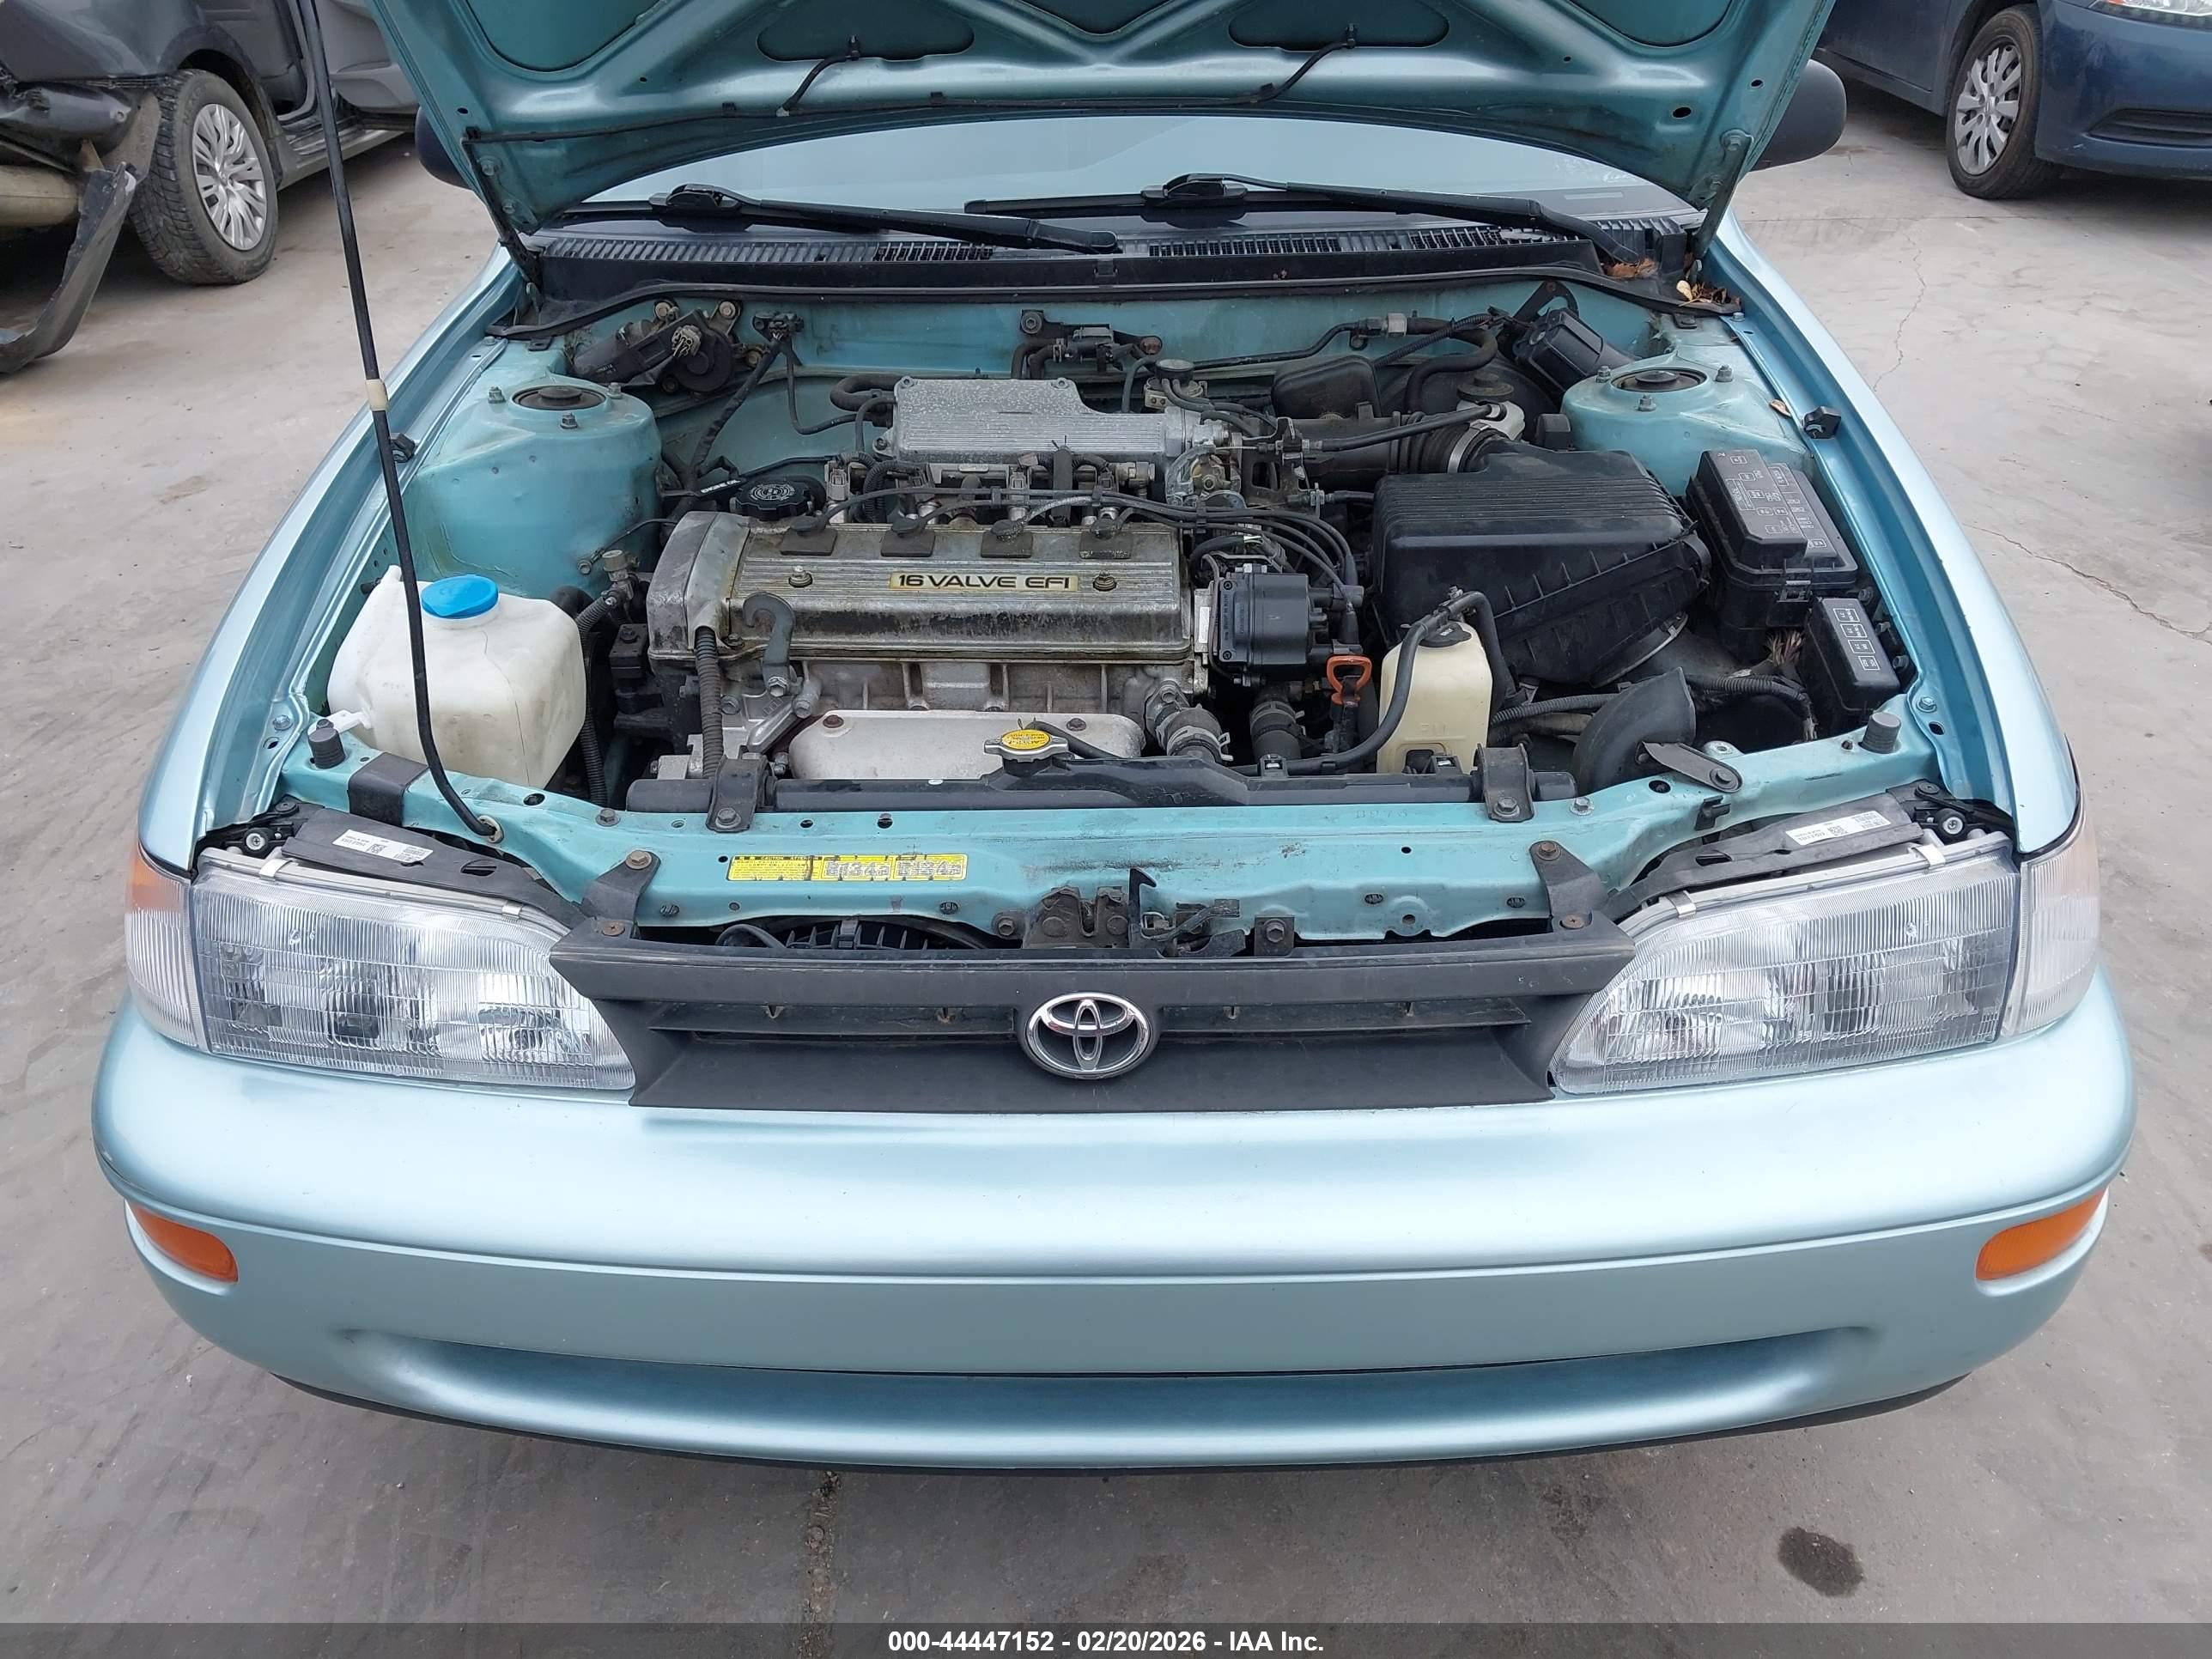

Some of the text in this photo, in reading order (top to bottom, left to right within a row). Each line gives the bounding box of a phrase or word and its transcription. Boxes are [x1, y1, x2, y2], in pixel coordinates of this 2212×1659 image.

[899, 574, 1070, 589] 16 VALVE EFI
